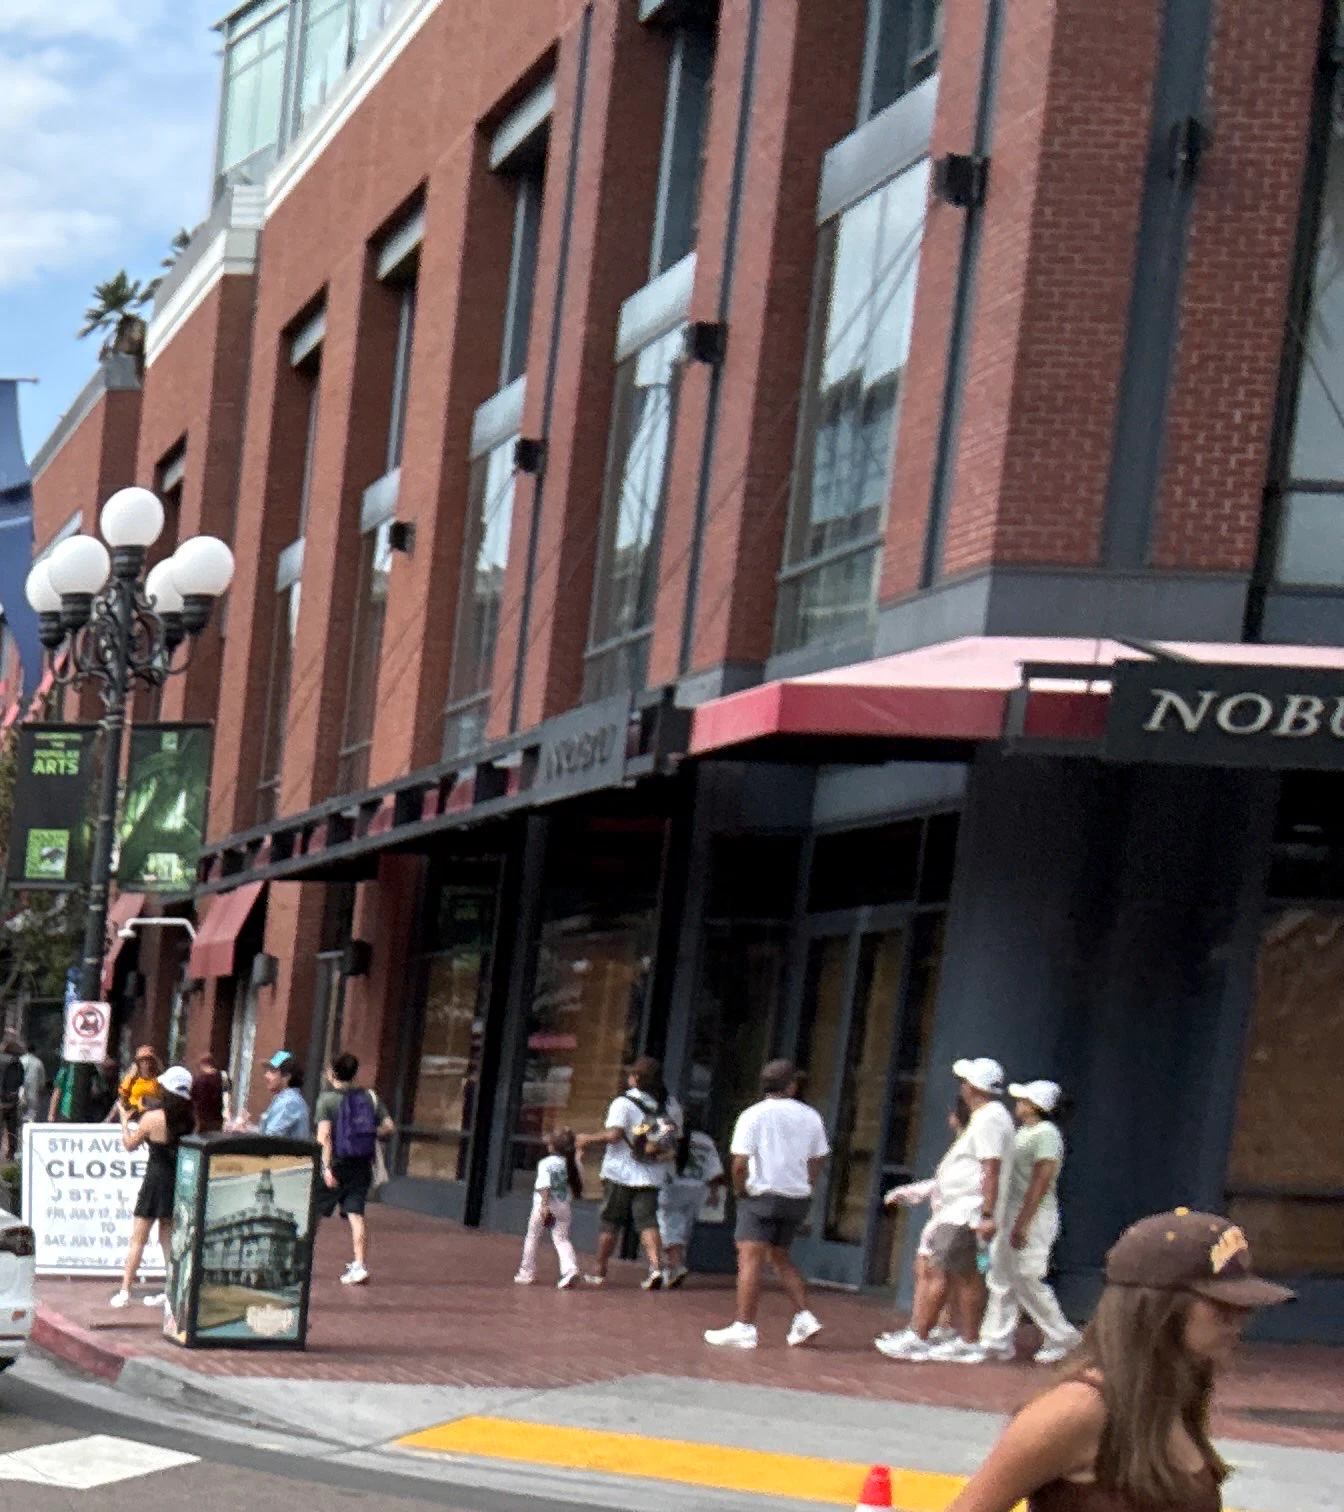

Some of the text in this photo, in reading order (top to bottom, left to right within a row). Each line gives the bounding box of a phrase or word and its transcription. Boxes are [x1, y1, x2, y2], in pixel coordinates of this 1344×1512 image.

[32, 760, 80, 777] ARTS
[48, 1138, 83, 1153] 5TH
[45, 1160, 149, 1179] CLOSE
[50, 1189, 62, 1202] J
[100, 1221, 116, 1234] TO
